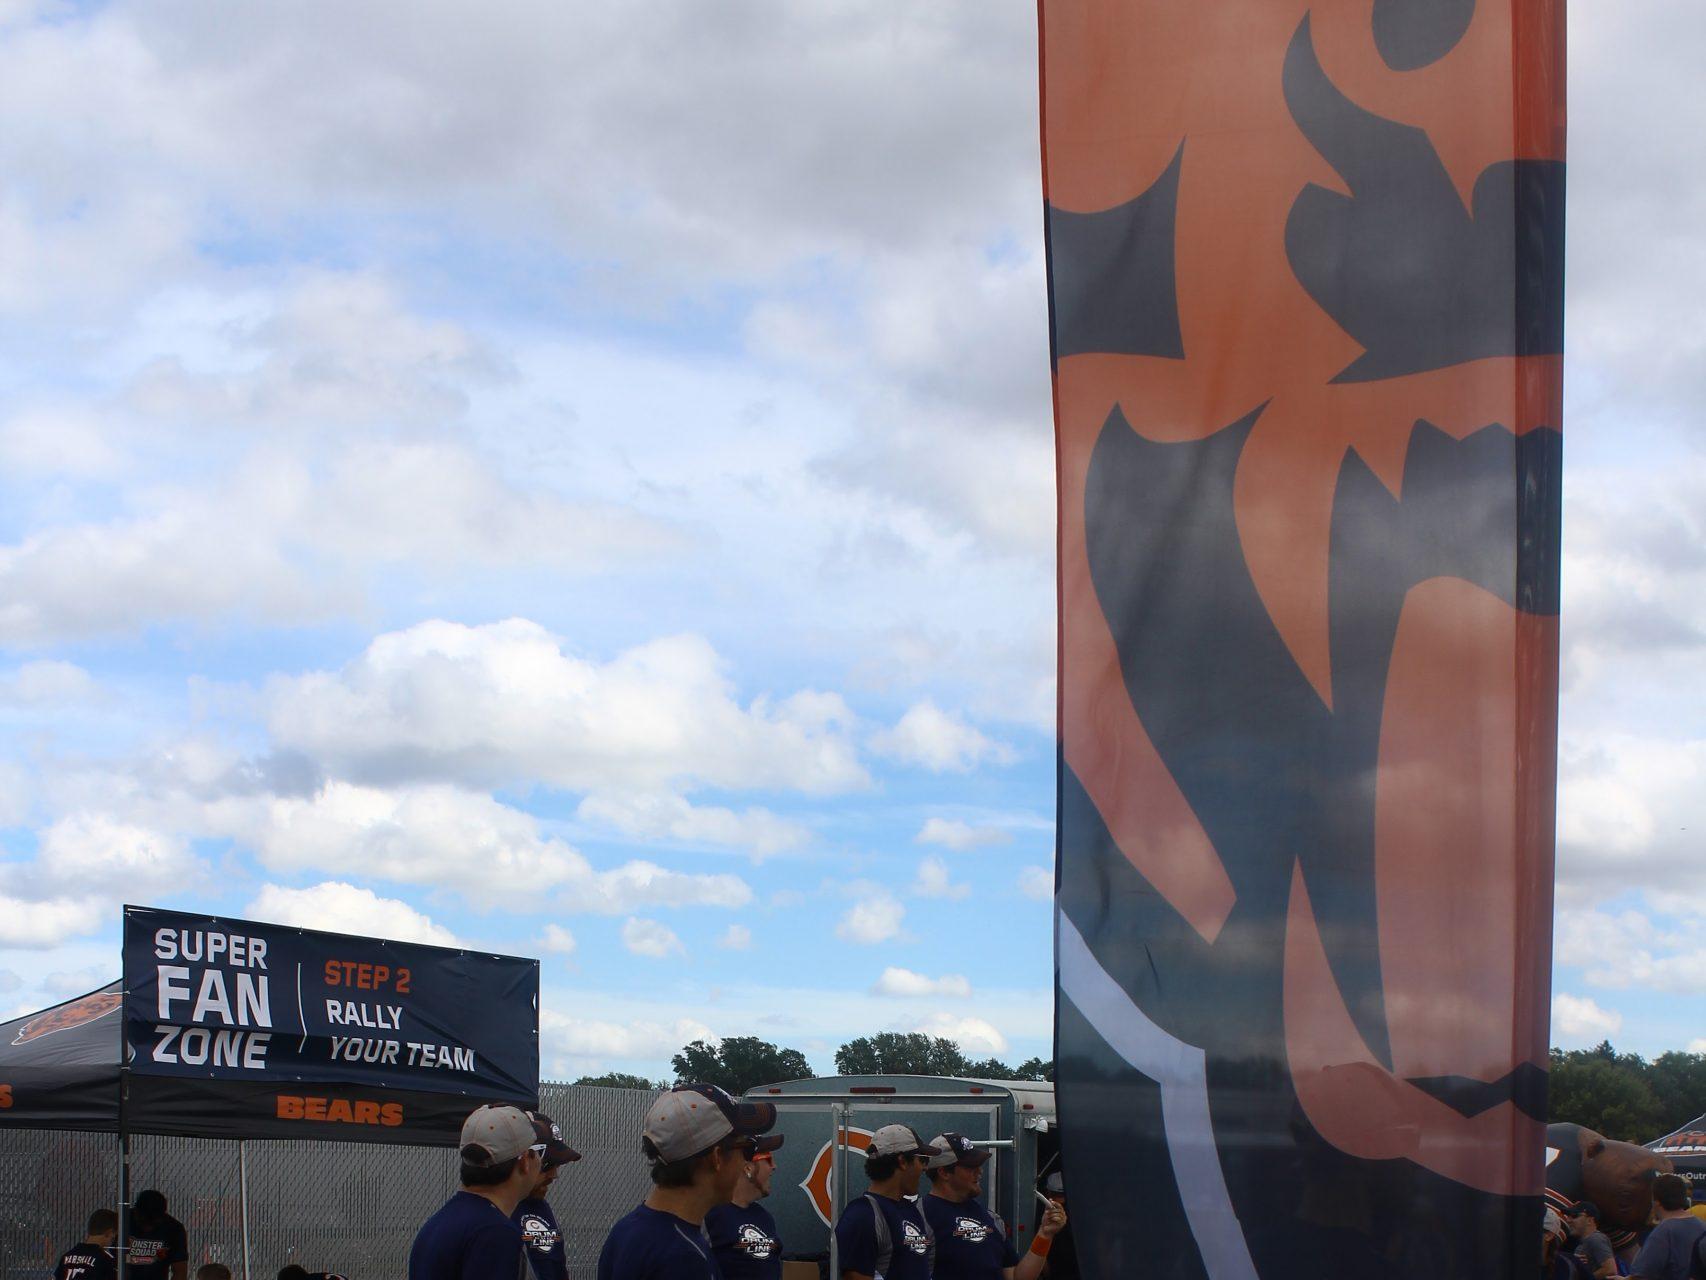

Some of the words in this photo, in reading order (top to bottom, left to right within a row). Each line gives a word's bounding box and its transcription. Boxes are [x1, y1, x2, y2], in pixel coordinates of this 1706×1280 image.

[154, 927, 268, 970] SUPER
[324, 959, 389, 992] STEP
[396, 968, 412, 994] 2
[157, 965, 273, 1028] FAN
[326, 999, 403, 1030] RALLY
[152, 1025, 273, 1070] ZONE
[329, 1036, 401, 1065] YOUR
[406, 1041, 476, 1073] TEAM
[276, 1095, 405, 1127] BEARS
